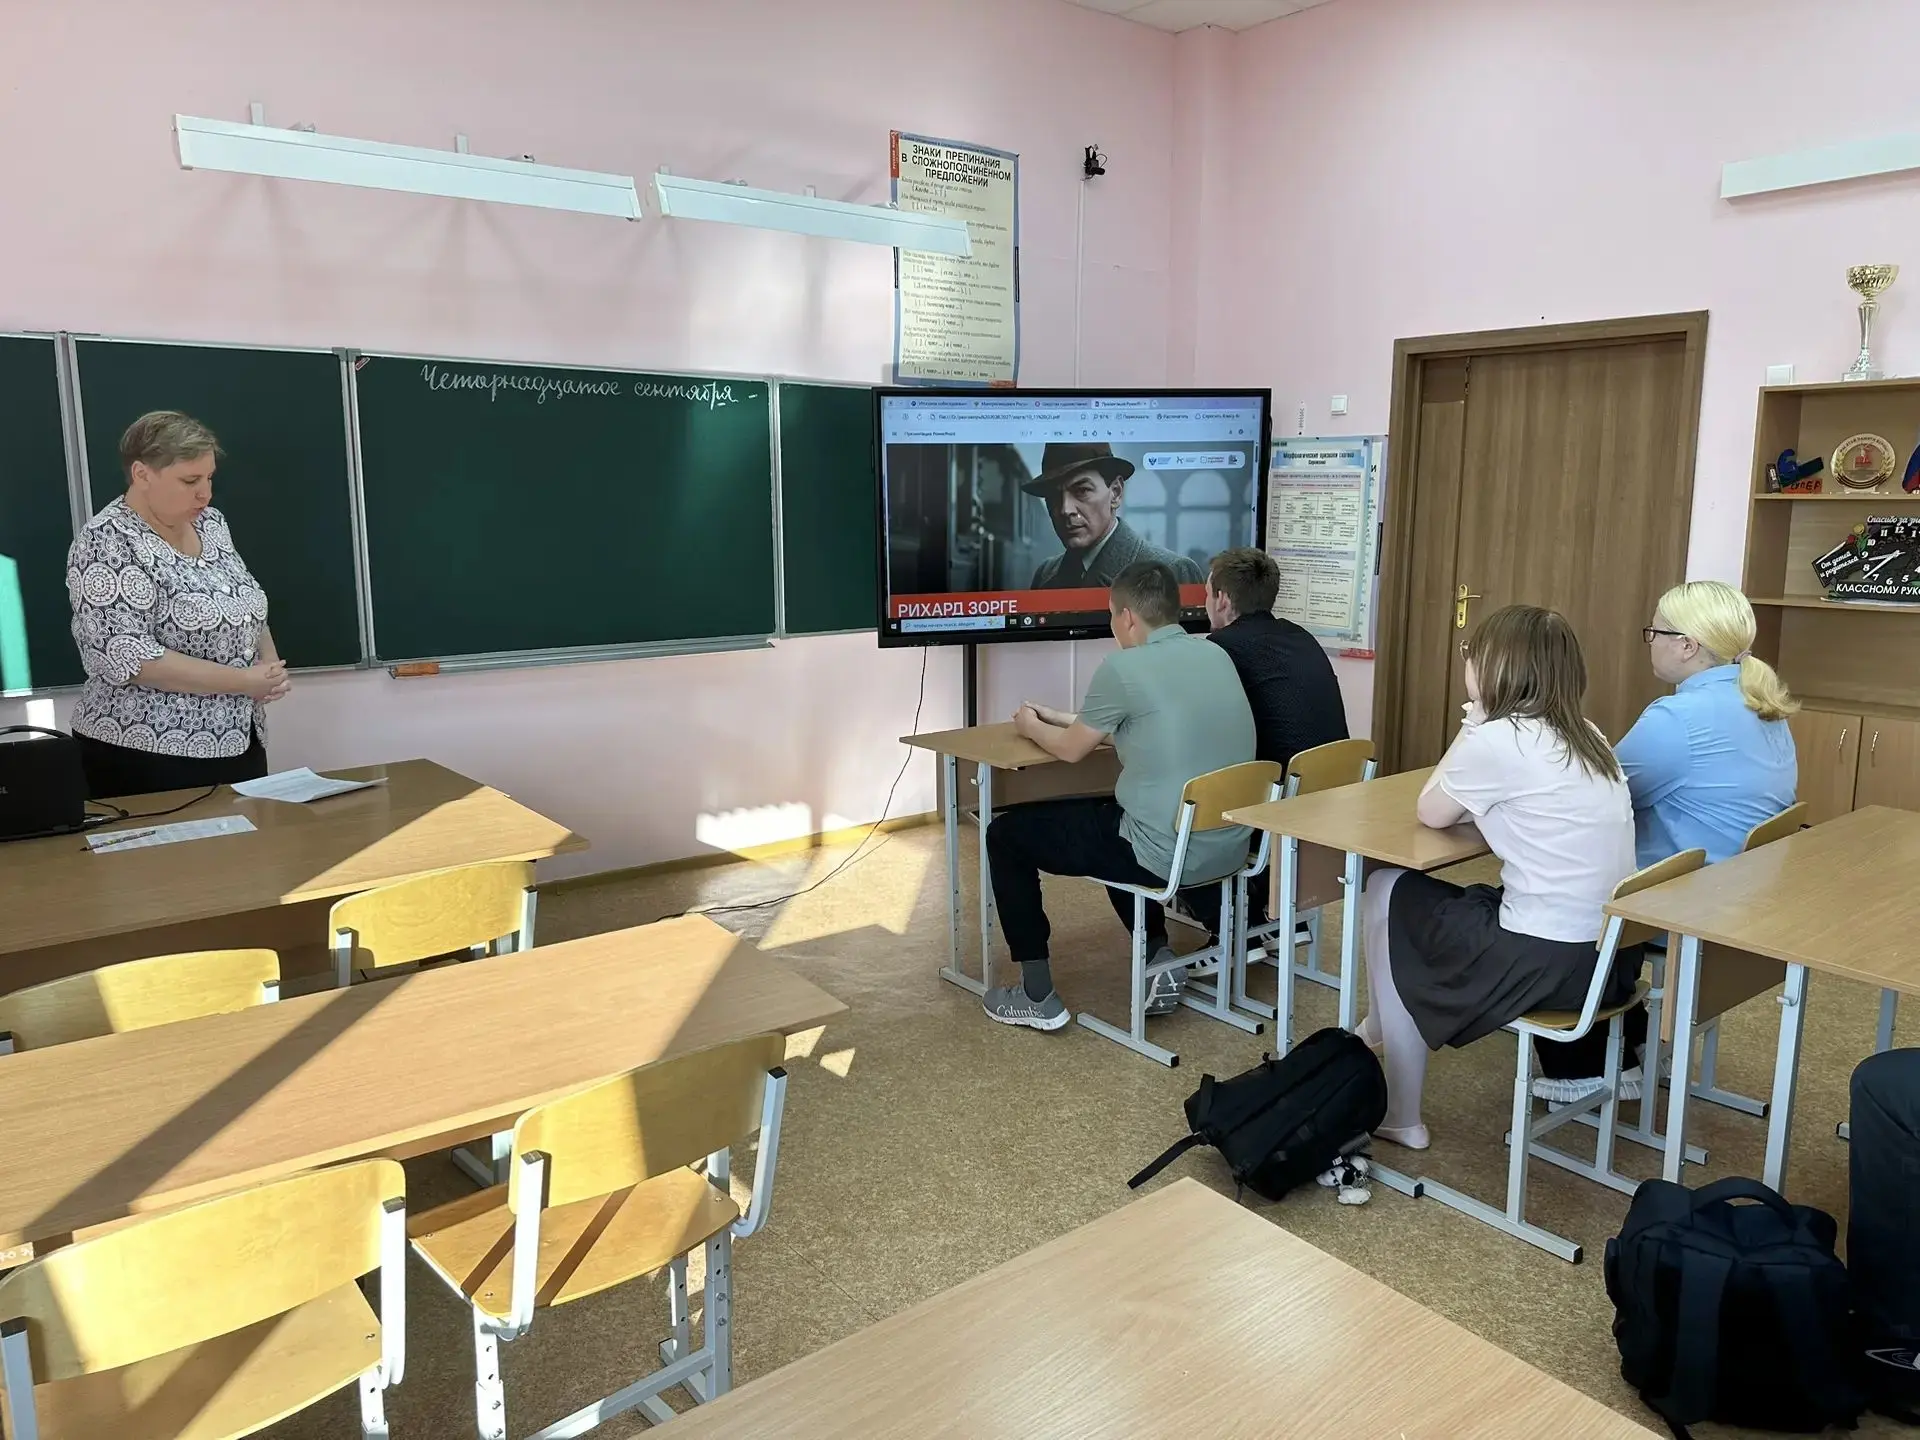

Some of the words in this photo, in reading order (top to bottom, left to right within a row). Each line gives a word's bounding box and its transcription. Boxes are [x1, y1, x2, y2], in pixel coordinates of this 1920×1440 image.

[901, 153, 908, 162] В
[913, 144, 941, 158] ЗНАКИ
[945, 150, 1001, 169] ПРЕПИНАНИЯ
[925, 168, 989, 188] ПРЕДЛОЖЕНИИ
[634, 379, 739, 410] сентября
[1867, 515, 1897, 523] Спасибо
[1897, 517, 1908, 526] за
[1880, 529, 1888, 537] 11
[1894, 526, 1904, 534] 12
[1820, 561, 1832, 569] От
[1831, 550, 1852, 565] детей
[1861, 551, 1869, 559] 9
[1825, 555, 1859, 577] родителей
[1862, 564, 1870, 572] 8
[1872, 573, 1880, 581] 7
[1885, 577, 1893, 585] 6
[1901, 574, 1910, 583] 5
[1836, 583, 1899, 595] КЛАССНОМУ
[898, 602, 964, 618] РИХАРД
[968, 600, 1018, 616] ЗОРГЕ
[996, 1004, 1046, 1018] Columbia
